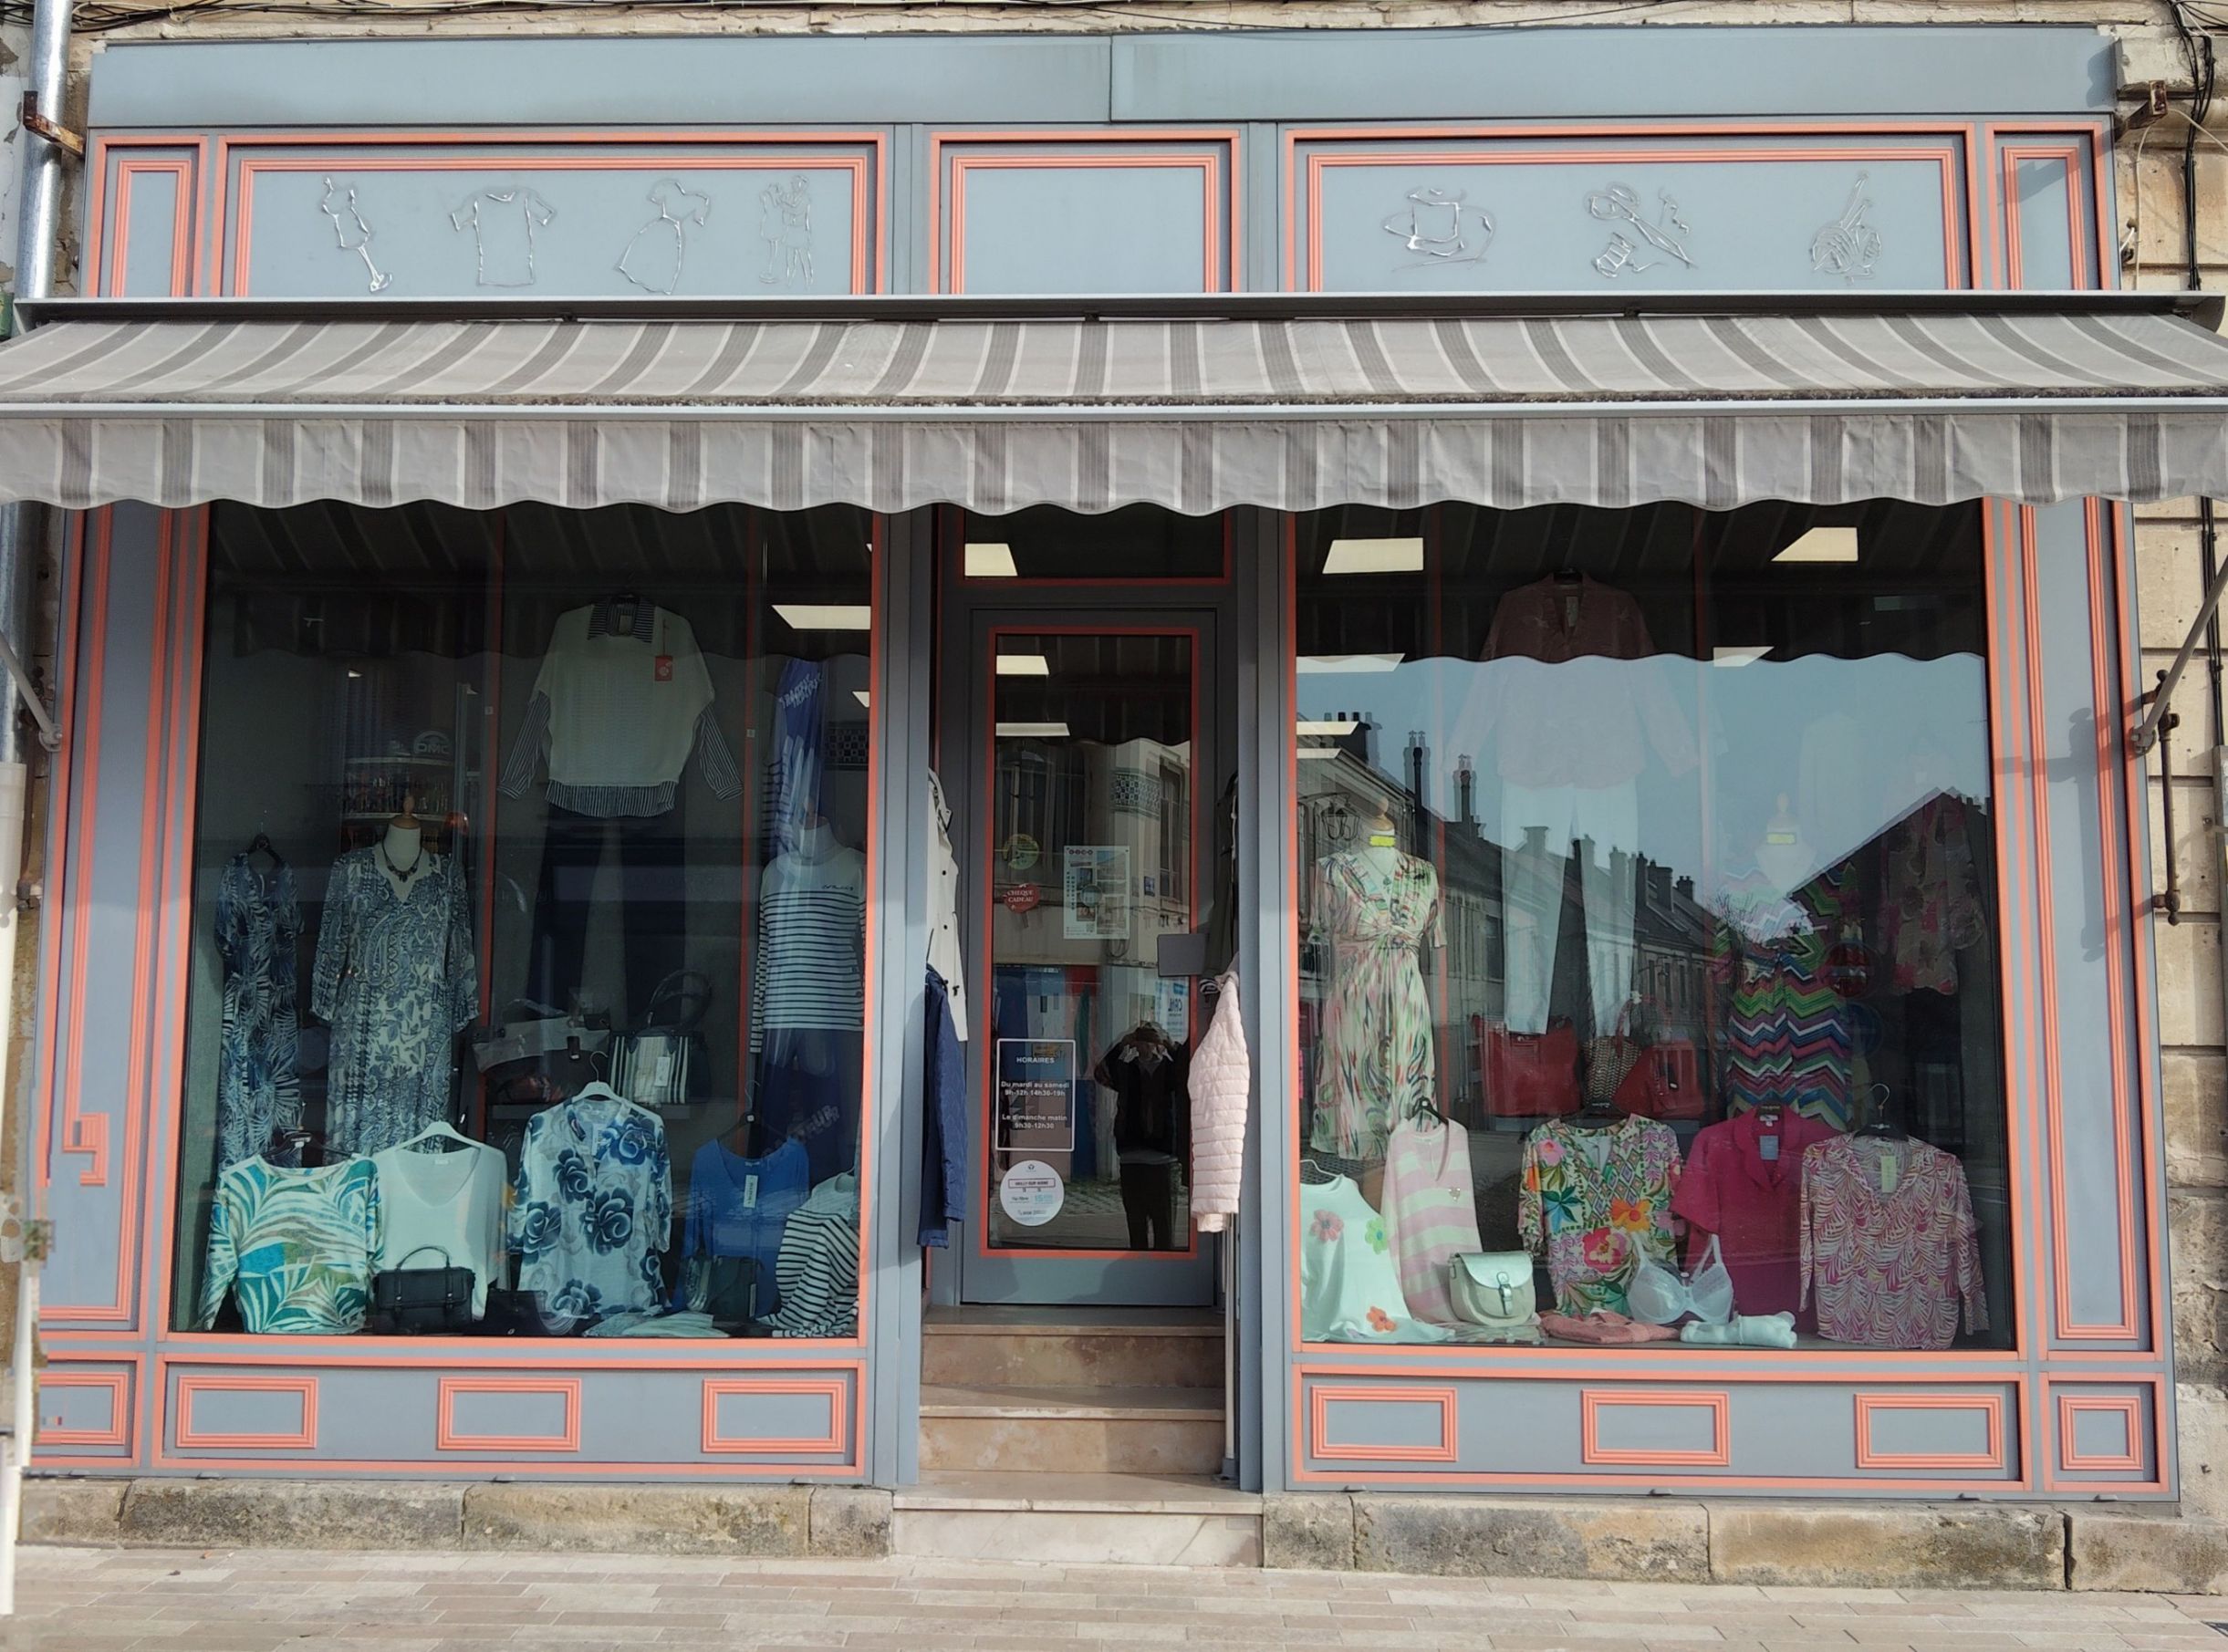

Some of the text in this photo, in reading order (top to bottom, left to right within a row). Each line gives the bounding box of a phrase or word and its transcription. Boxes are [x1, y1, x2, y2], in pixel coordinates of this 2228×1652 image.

[415, 743, 449, 753] DMC
[1002, 1113, 1011, 1121] Le
[1012, 1113, 1046, 1121] dimanche
